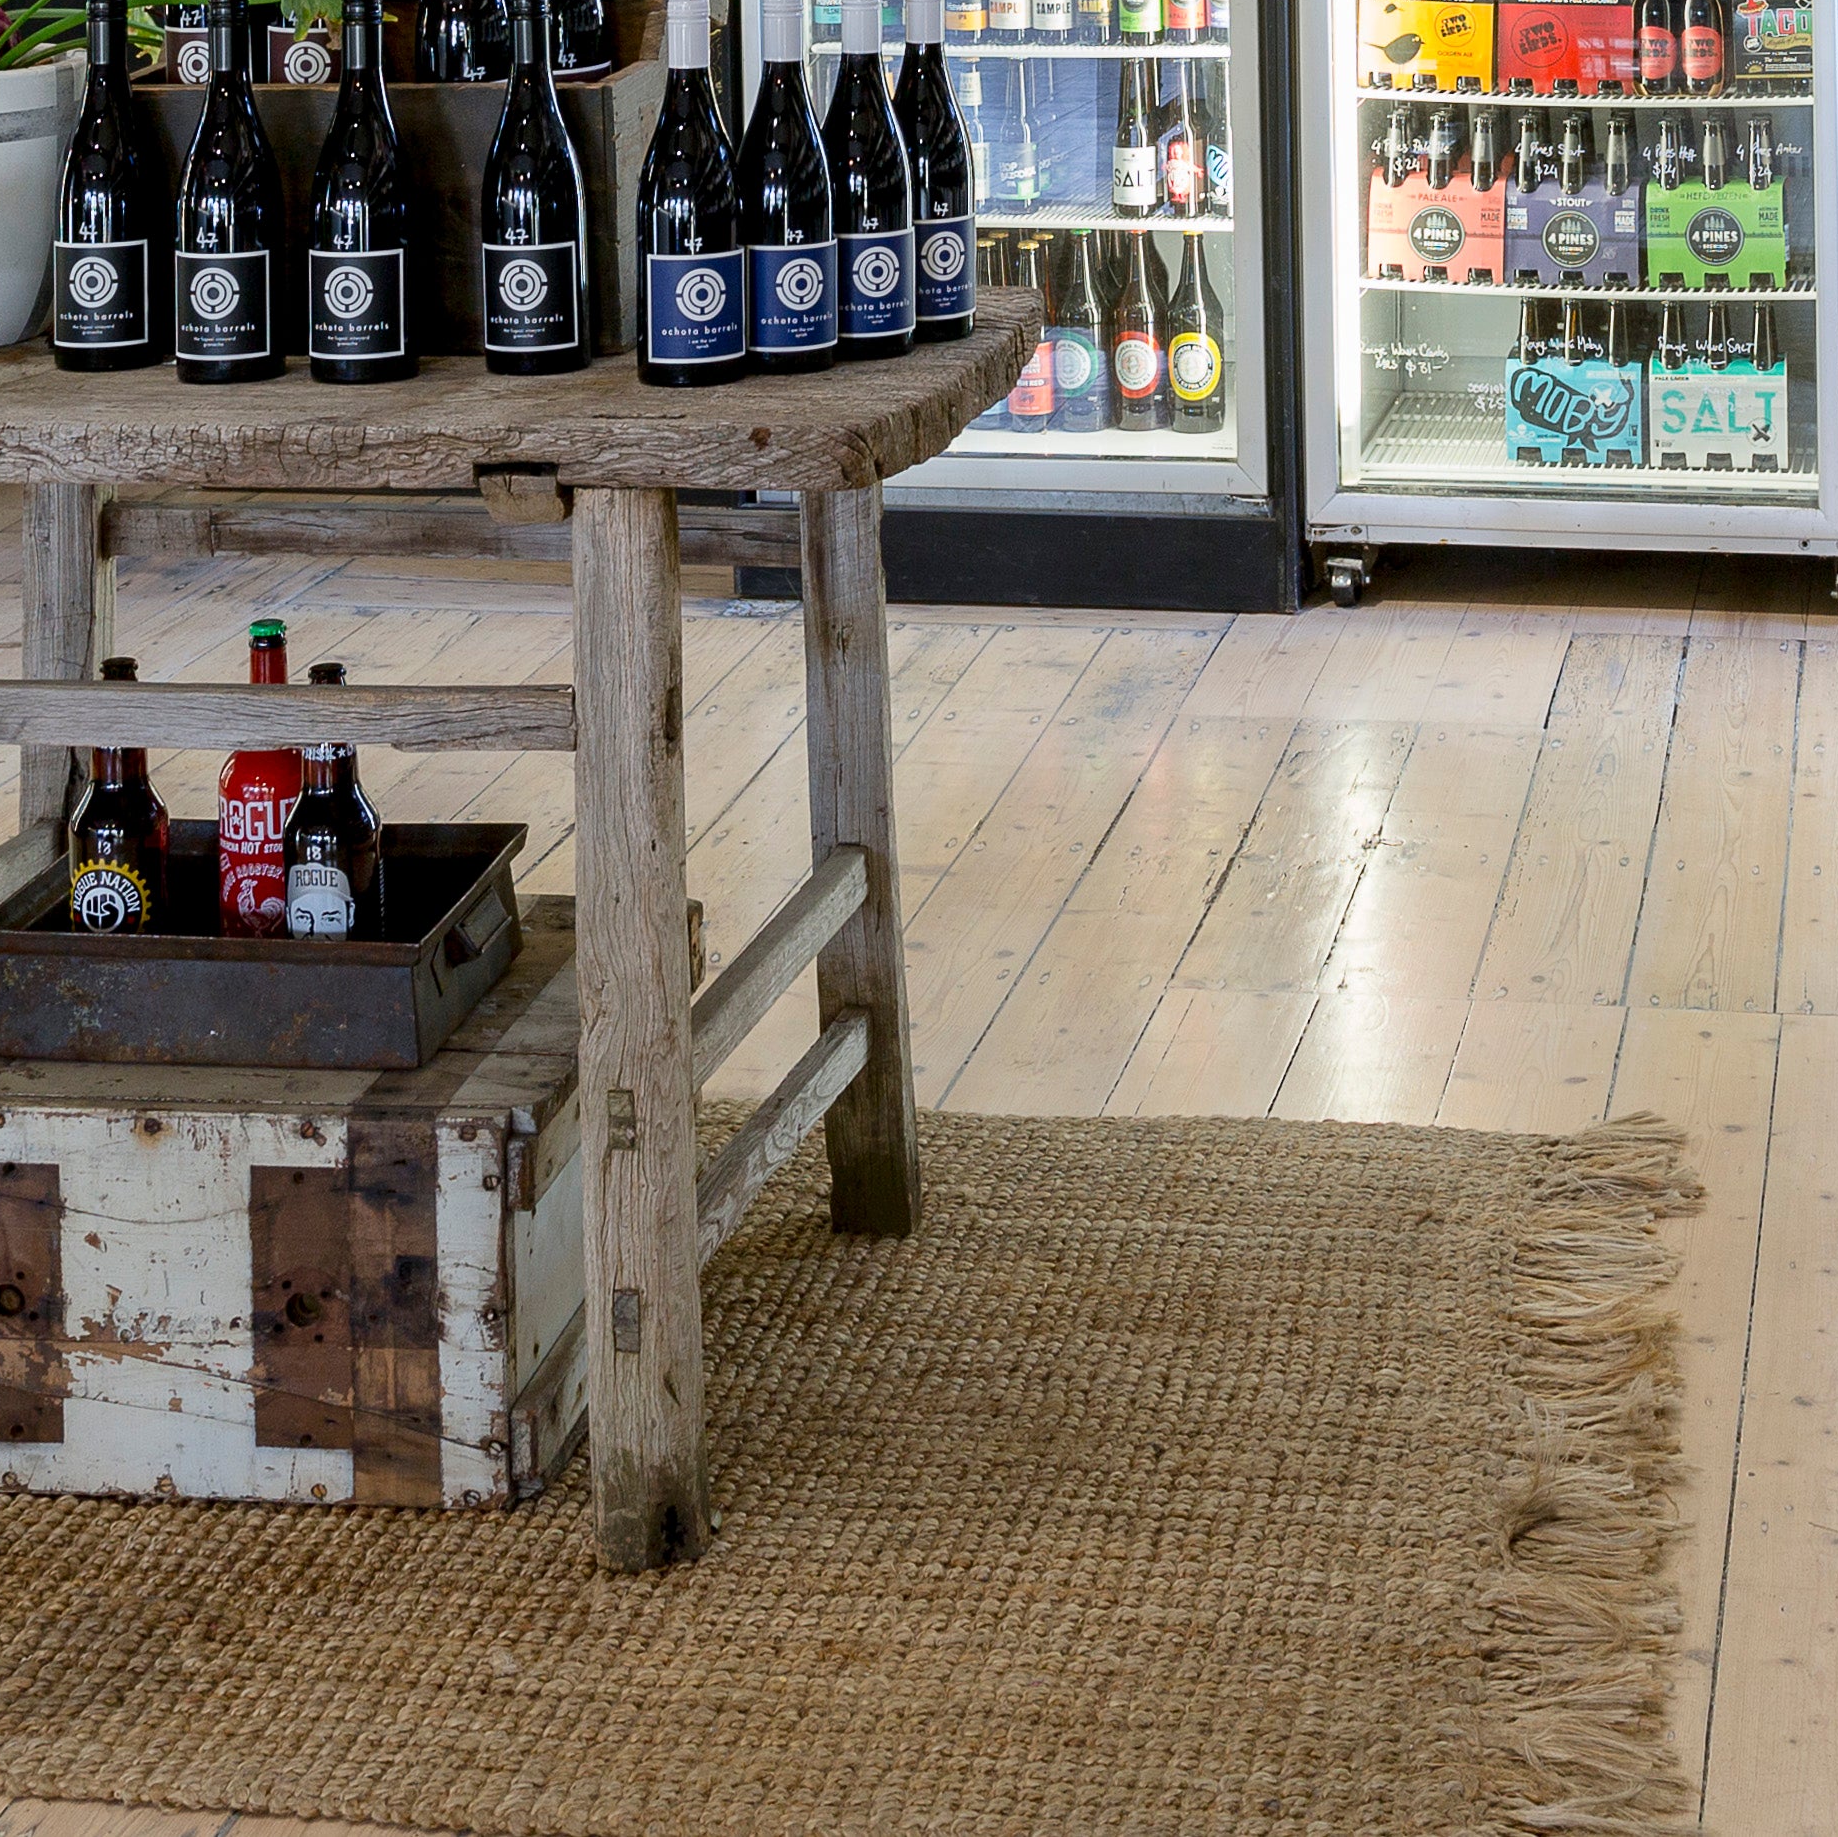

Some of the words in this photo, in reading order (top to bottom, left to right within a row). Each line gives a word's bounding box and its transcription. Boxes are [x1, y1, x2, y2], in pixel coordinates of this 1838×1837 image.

[1036, 2, 1071, 14] SAMPLE
[1113, 166, 1156, 187] SALT
[933, 201, 950, 215] 47
[1556, 198, 1586, 208] STOUT
[77, 221, 98, 241] 47
[862, 217, 880, 230] 47
[195, 225, 219, 249] 47
[333, 233, 354, 251] 47
[505, 226, 529, 245] 47
[786, 229, 804, 243] 47
[1413, 228, 1422, 240] 4
[1423, 228, 1460, 243] PINES
[1548, 234, 1557, 244] 4
[1558, 232, 1594, 246] PINES
[1692, 231, 1700, 242] 4
[1702, 229, 1739, 244] PINES
[684, 237, 703, 252] 47
[760, 316, 798, 326] ochota
[803, 311, 834, 324] barrels
[661, 326, 699, 337] ochota
[703, 322, 738, 335] barrels
[1514, 367, 1630, 436] MOBY
[1662, 388, 1778, 435] SALT
[241, 841, 260, 856] HOT
[306, 845, 322, 861] 18
[295, 869, 338, 887] ROGUE
[73, 873, 97, 912] ROGUE
[100, 870, 141, 913] NATION
